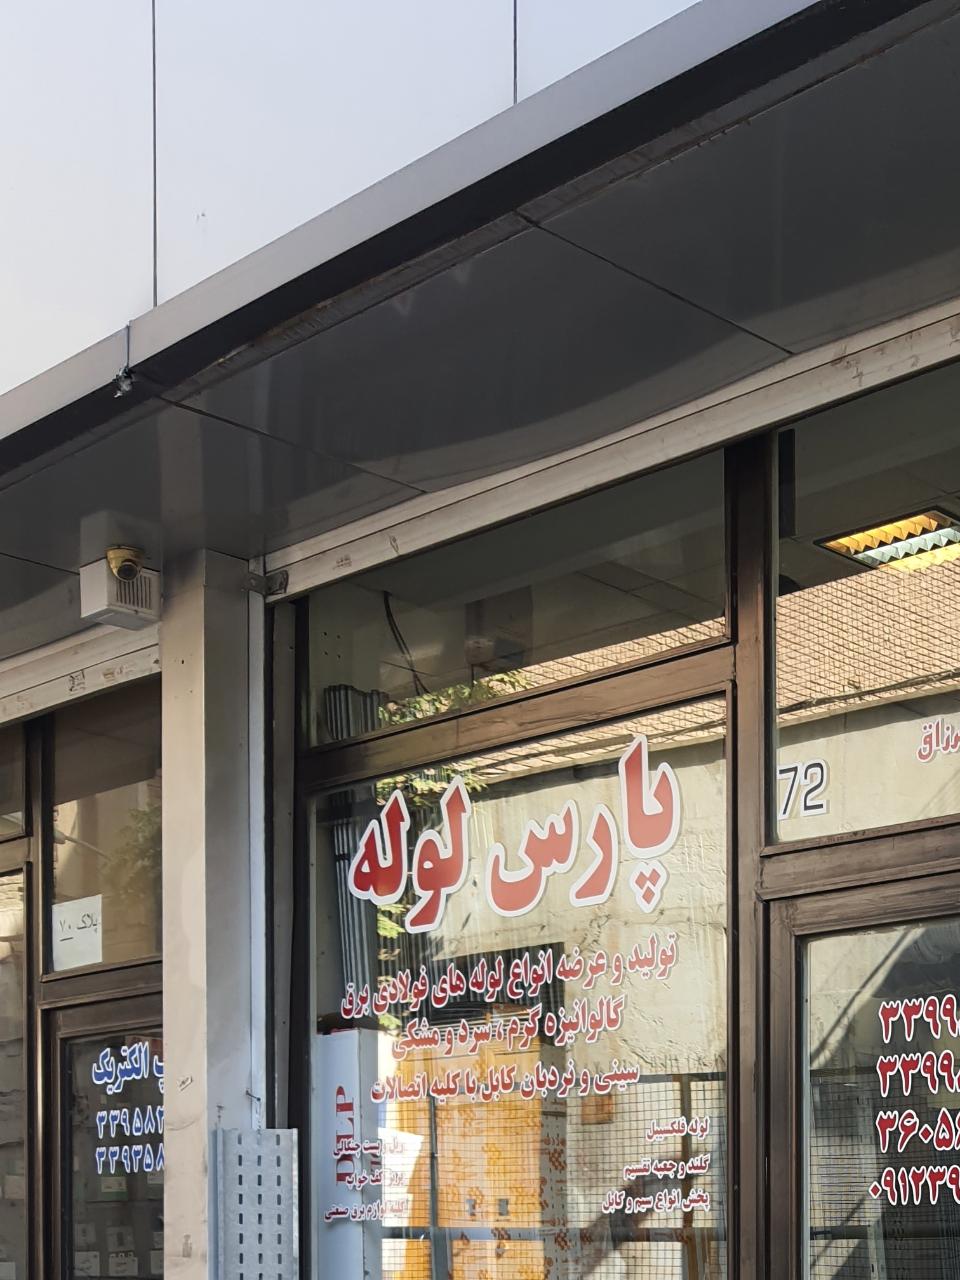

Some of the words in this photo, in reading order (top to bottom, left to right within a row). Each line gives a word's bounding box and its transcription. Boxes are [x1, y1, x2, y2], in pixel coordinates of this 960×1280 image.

[778, 759, 827, 820] 72
[486, 734, 681, 917] پارس
[350, 774, 472, 934] لوله
[507, 949, 553, 998] انواع
[557, 946, 606, 990] عرضه
[611, 953, 623, 986] و
[628, 932, 678, 980] تولید
[373, 966, 428, 1013] فولادی
[432, 963, 466, 1007] های
[469, 956, 503, 1002] لوله
[341, 982, 369, 1018] برق
[458, 1018, 491, 1054] سرد
[506, 1003, 542, 1050] گرم
[545, 994, 625, 1047] گالوانیزه
[392, 1017, 440, 1061] مشکی
[445, 1029, 455, 1056] و
[92, 1041, 149, 1095] الکتریک
[464, 1068, 477, 1103] با
[482, 1063, 516, 1102] کابل
[519, 1059, 576, 1100] نردبان
[580, 1068, 589, 1096] و
[594, 1058, 640, 1096] سینی
[370, 1072, 428, 1105] اتصالات
[430, 1071, 460, 1104] کلیه
[646, 1116, 687, 1141] فلکسیبل
[688, 1116, 710, 1139] لوله
[624, 1157, 651, 1180] تقسیم
[652, 1159, 677, 1179] جعبه
[677, 1161, 685, 1179] و
[687, 1153, 710, 1174] گلند
[602, 1191, 625, 1215] کابل
[625, 1197, 633, 1213] و
[634, 1196, 653, 1213] سیم
[654, 1189, 681, 1212] انواع
[682, 1188, 710, 1212] پخش
